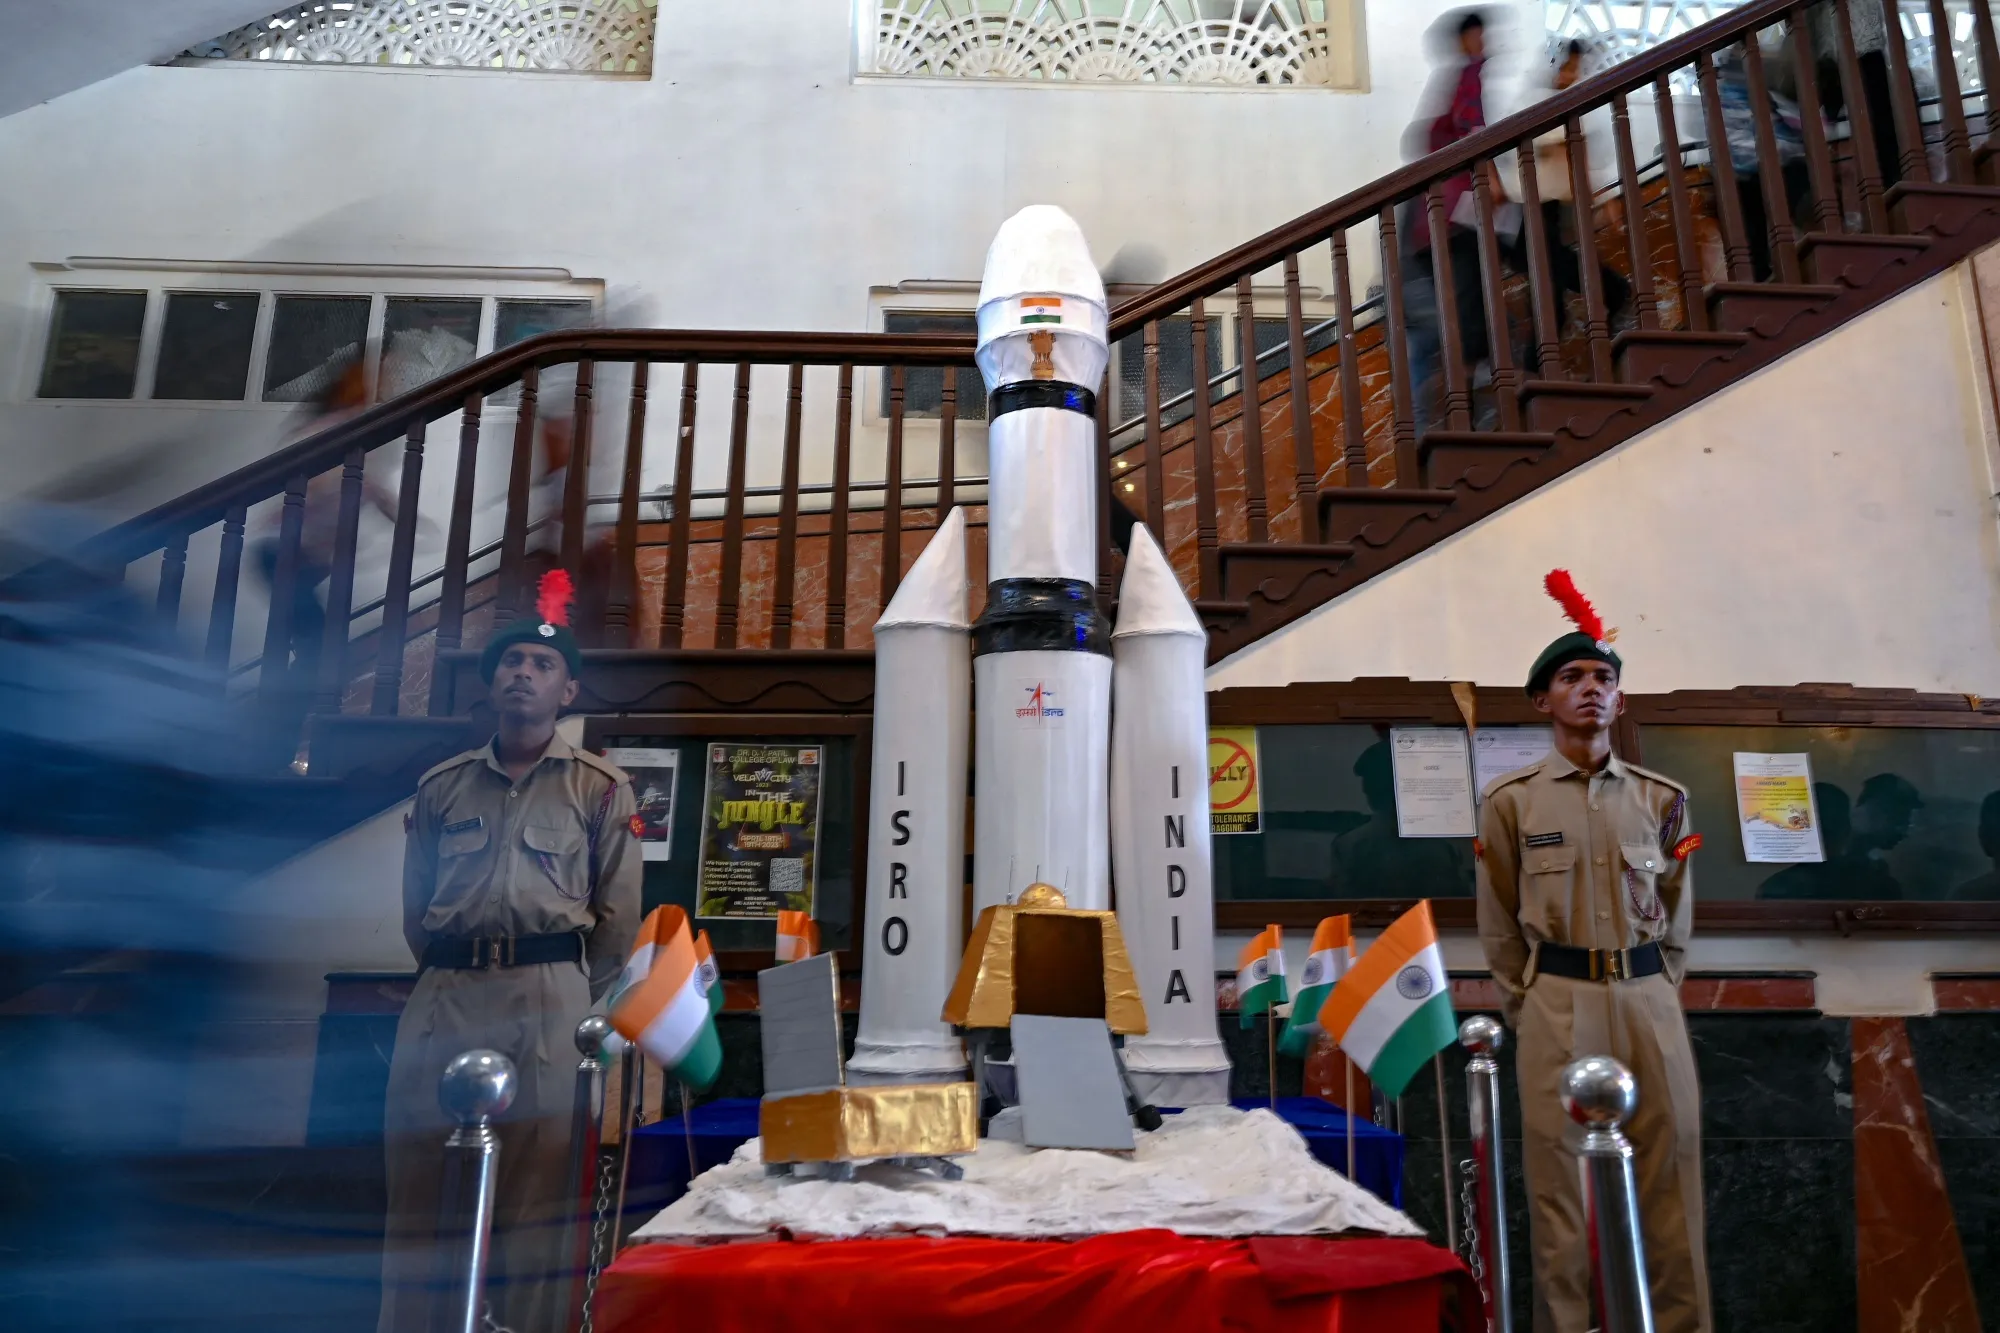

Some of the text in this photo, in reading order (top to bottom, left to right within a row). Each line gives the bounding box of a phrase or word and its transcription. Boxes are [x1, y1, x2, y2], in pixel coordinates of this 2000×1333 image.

[728, 756, 765, 764] COLLEGE
[756, 791, 792, 803] THE
[717, 801, 808, 831] JUNGLE
[1211, 814, 1252, 824] TOLERANCE
[881, 761, 911, 956] ISRO
[1163, 766, 1191, 1005] INDIA
